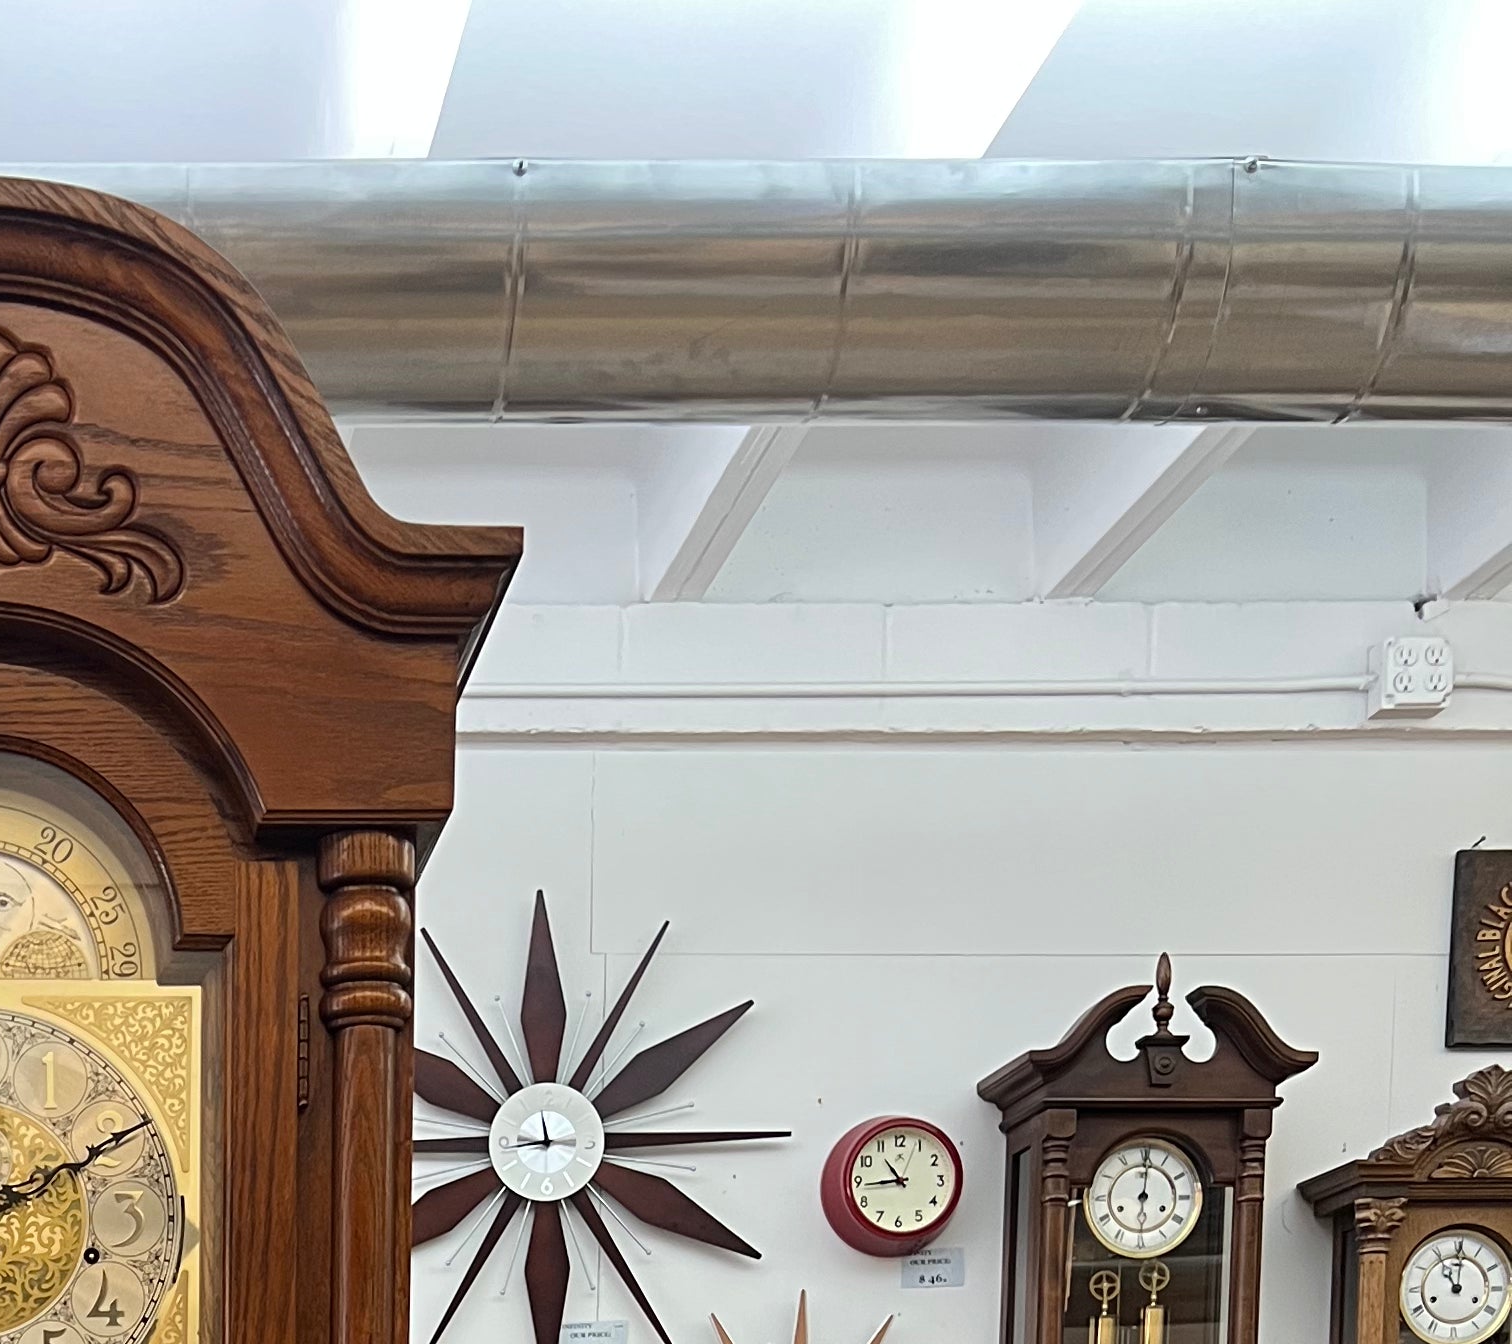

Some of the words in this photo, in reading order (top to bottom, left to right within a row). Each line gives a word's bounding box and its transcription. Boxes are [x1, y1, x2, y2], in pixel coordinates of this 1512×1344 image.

[34, 826, 73, 864] 20
[91, 885, 126, 926] 25
[110, 942, 138, 977] 29
[41, 1051, 57, 1109] 1
[94, 1110, 124, 1168] 2
[894, 1135, 906, 1148] 12
[877, 1140, 884, 1152] 11
[860, 1155, 873, 1168] 10
[930, 1154, 938, 1166] 2
[540, 1177, 554, 1195] 6
[854, 1176, 862, 1188] 9
[937, 1175, 944, 1187] 3
[860, 1196, 868, 1208] 8
[929, 1195, 937, 1206] 4
[110, 1190, 145, 1248] 3
[876, 1211, 884, 1222] 7
[894, 1216, 902, 1227] 6
[915, 1210, 923, 1222] 5
[86, 1269, 125, 1327] 4
